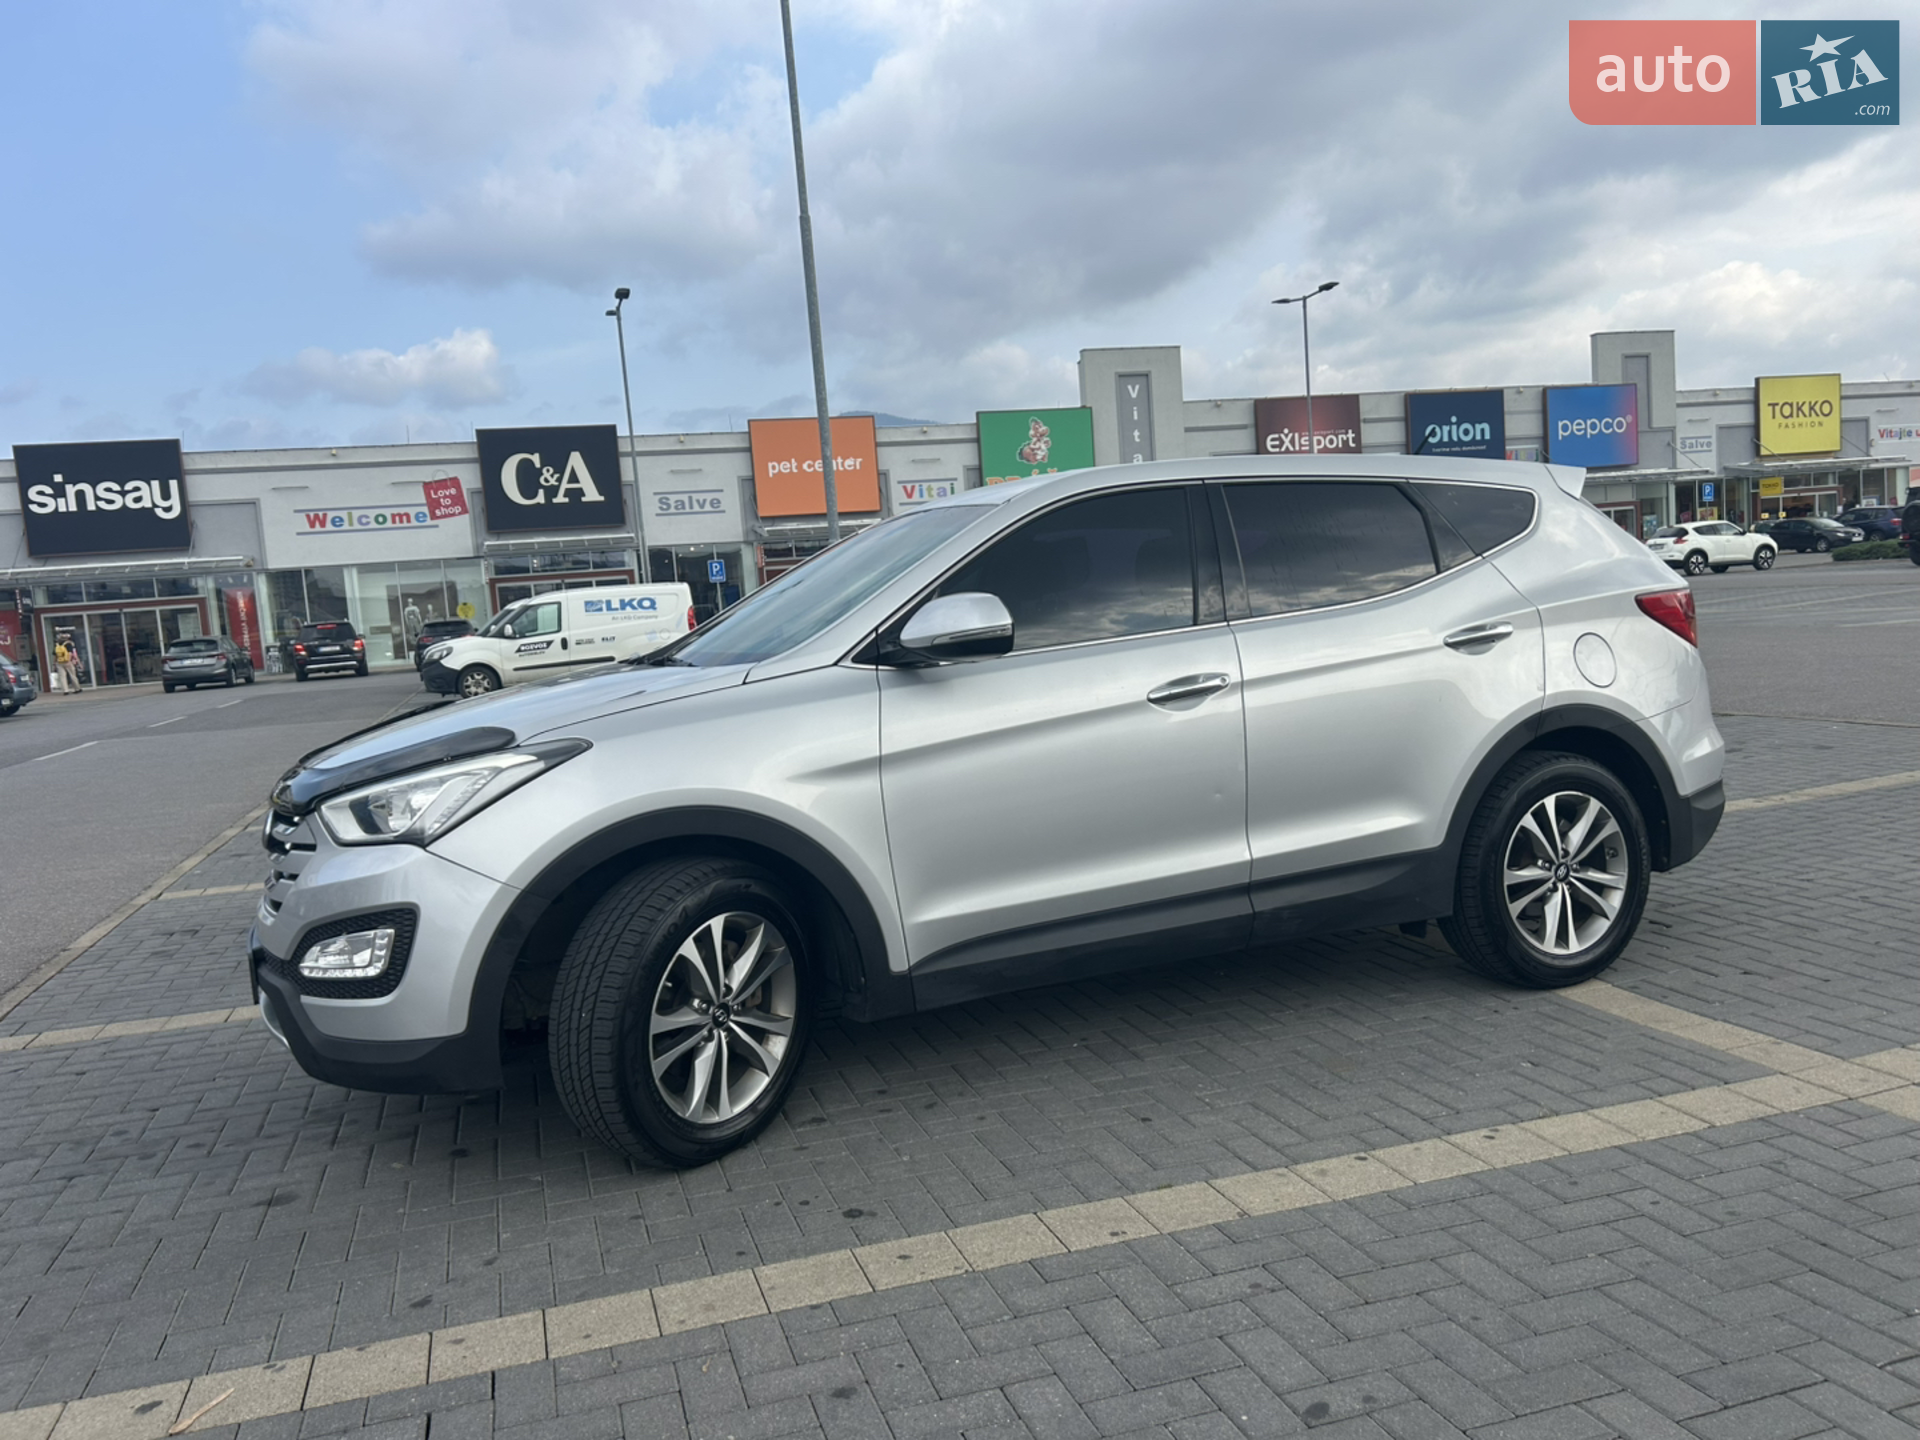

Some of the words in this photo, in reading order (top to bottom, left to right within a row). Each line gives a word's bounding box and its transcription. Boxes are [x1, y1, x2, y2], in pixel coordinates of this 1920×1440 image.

[1424, 415, 1491, 443] orion
[1778, 421, 1824, 429] FASHION
[1680, 439, 1712, 450] Salve
[768, 458, 798, 478] pet
[500, 450, 605, 505] C&A
[27, 473, 182, 520] sinsay
[431, 487, 457, 499] Love
[440, 498, 452, 506] to
[657, 495, 722, 512] Salve
[435, 505, 462, 517] shop
[305, 511, 429, 529] Welcome
[712, 562, 721, 575] P
[605, 597, 658, 613] LKQ
